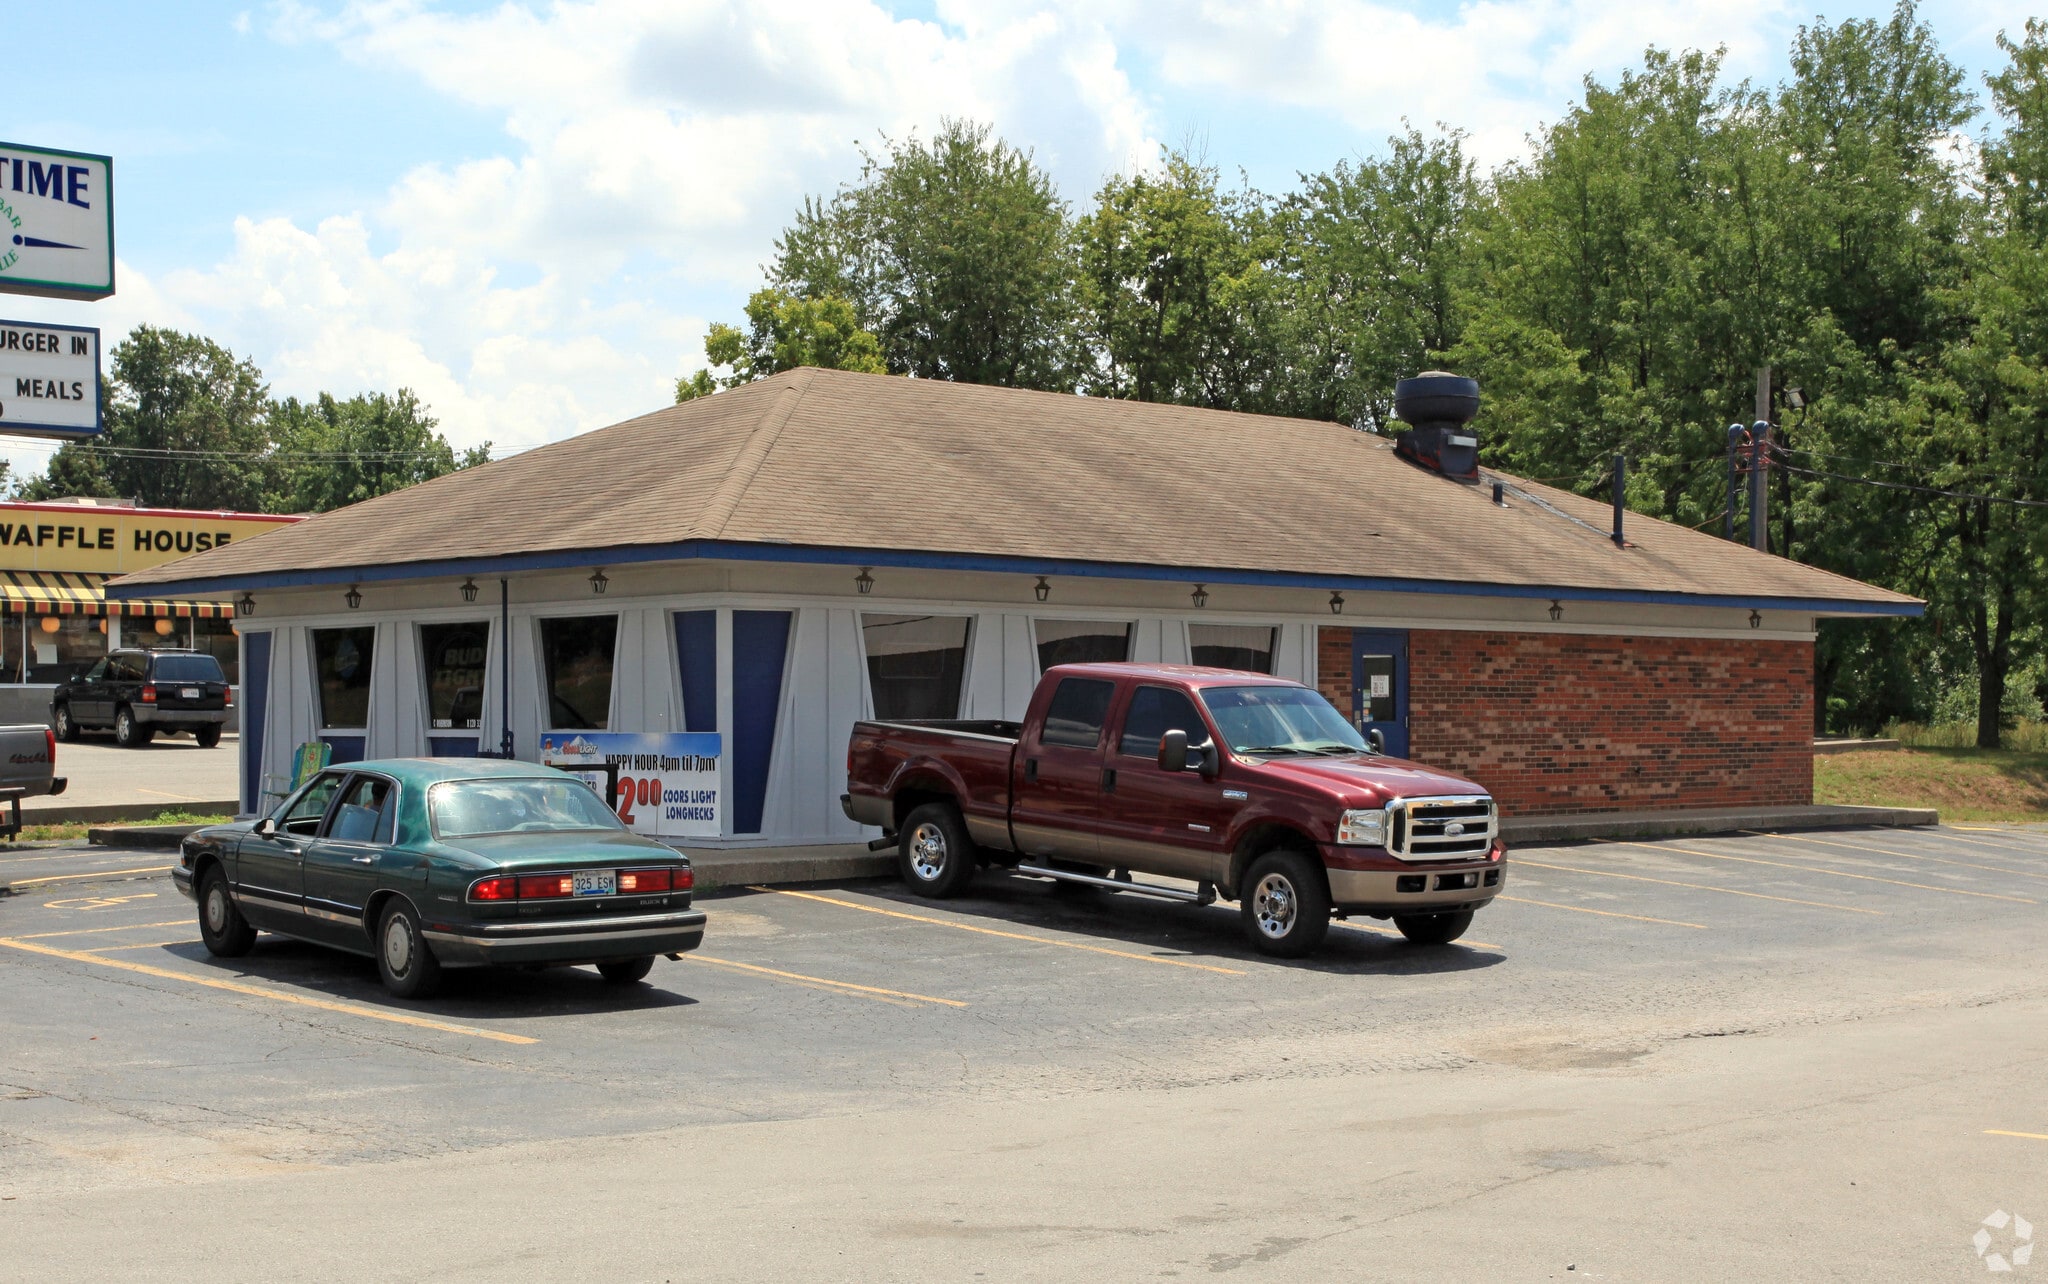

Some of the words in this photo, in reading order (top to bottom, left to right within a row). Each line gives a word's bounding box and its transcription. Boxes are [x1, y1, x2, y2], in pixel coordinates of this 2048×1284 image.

[71, 336, 87, 355] IN
[16, 378, 84, 400] MEALS
[0, 524, 115, 549] WAFFLE
[605, 754, 633, 770] HAPPY
[634, 754, 658, 771] HOUR
[660, 755, 680, 773] 4pm
[682, 755, 693, 771] til
[695, 755, 716, 773] 7pm
[663, 790, 689, 804] COORS
[691, 790, 717, 804] LIGHT
[666, 807, 714, 821] LONGNECKS
[575, 878, 592, 890] 325
